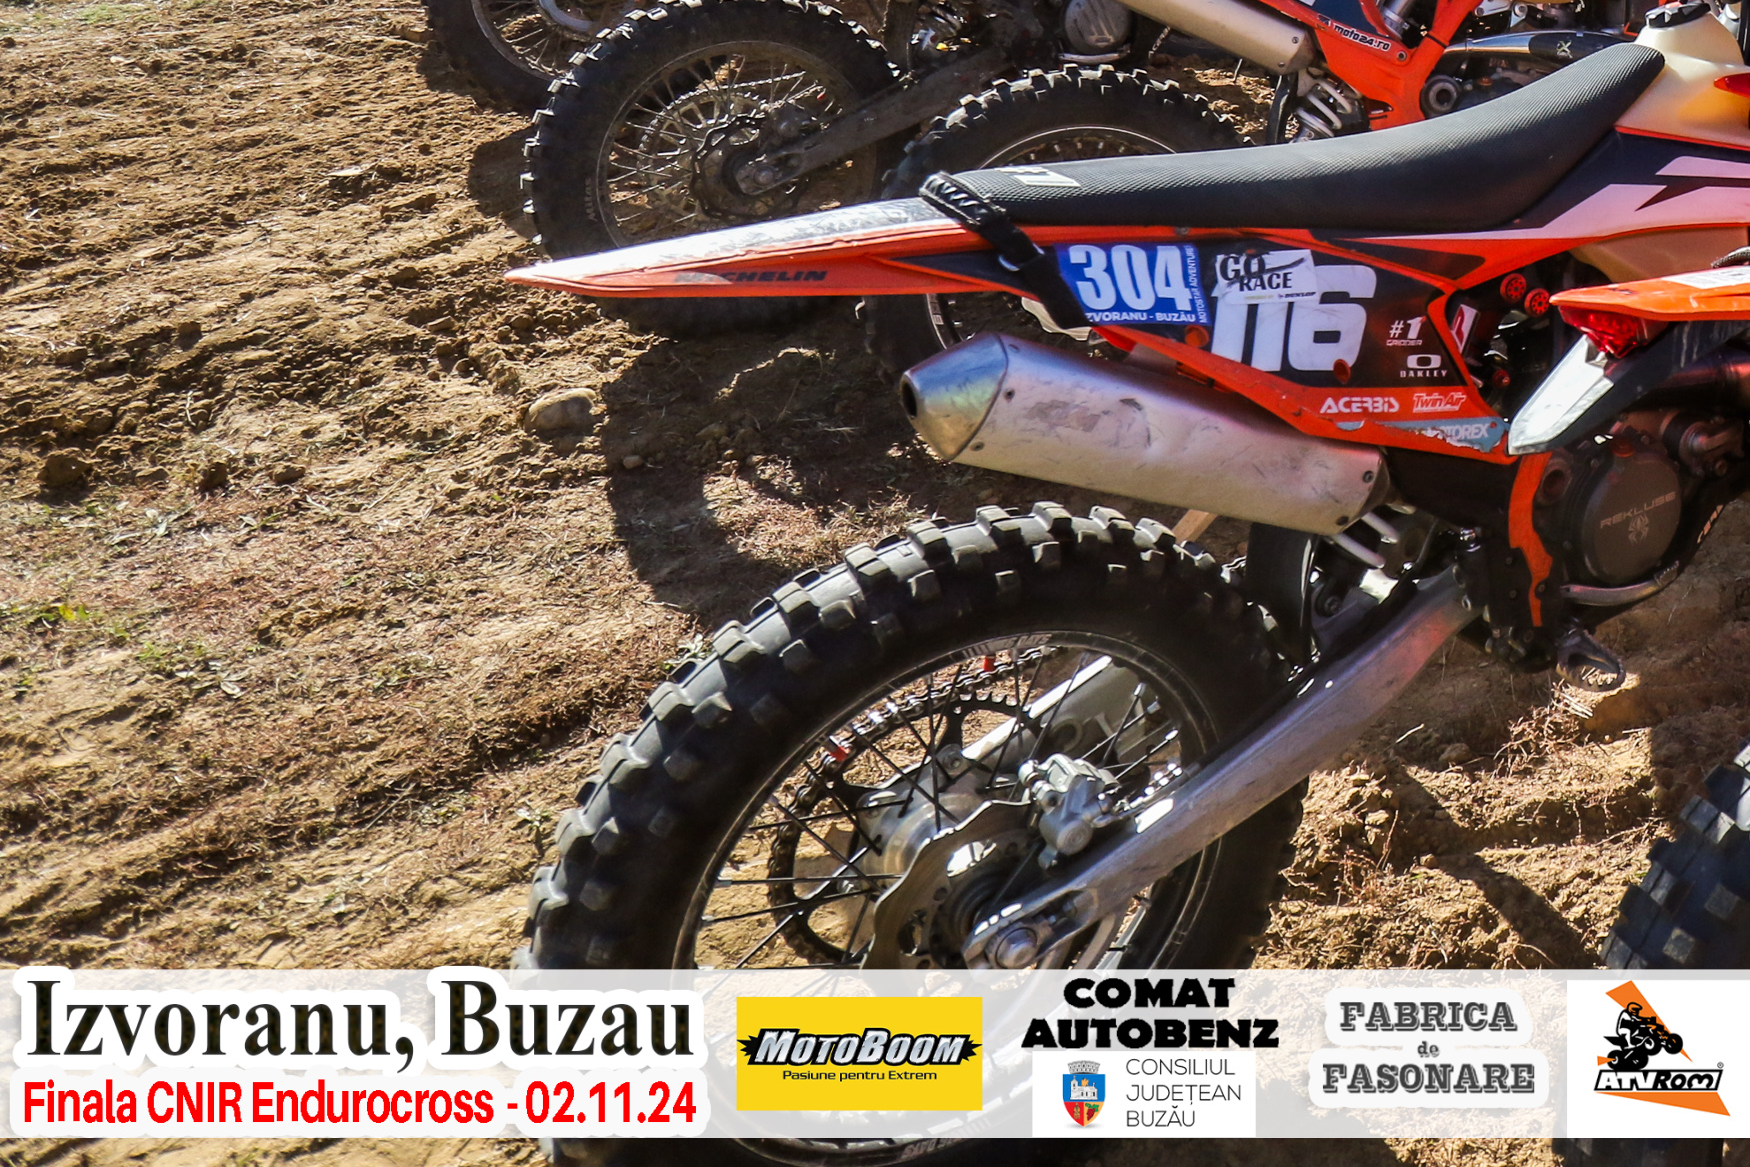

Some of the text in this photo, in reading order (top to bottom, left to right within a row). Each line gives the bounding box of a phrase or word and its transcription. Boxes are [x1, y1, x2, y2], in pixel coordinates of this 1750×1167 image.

[1333, 23, 1391, 52] moto24.ro
[1069, 244, 1193, 311] 304
[1219, 253, 1266, 282] GO
[1239, 271, 1293, 292] RACE
[1389, 315, 1427, 340] #1
[1400, 370, 1448, 378] OAKLEY
[1320, 396, 1400, 414] ACERBIS
[1427, 423, 1491, 440] TOREX
[1600, 491, 1676, 529] REKLUSE
